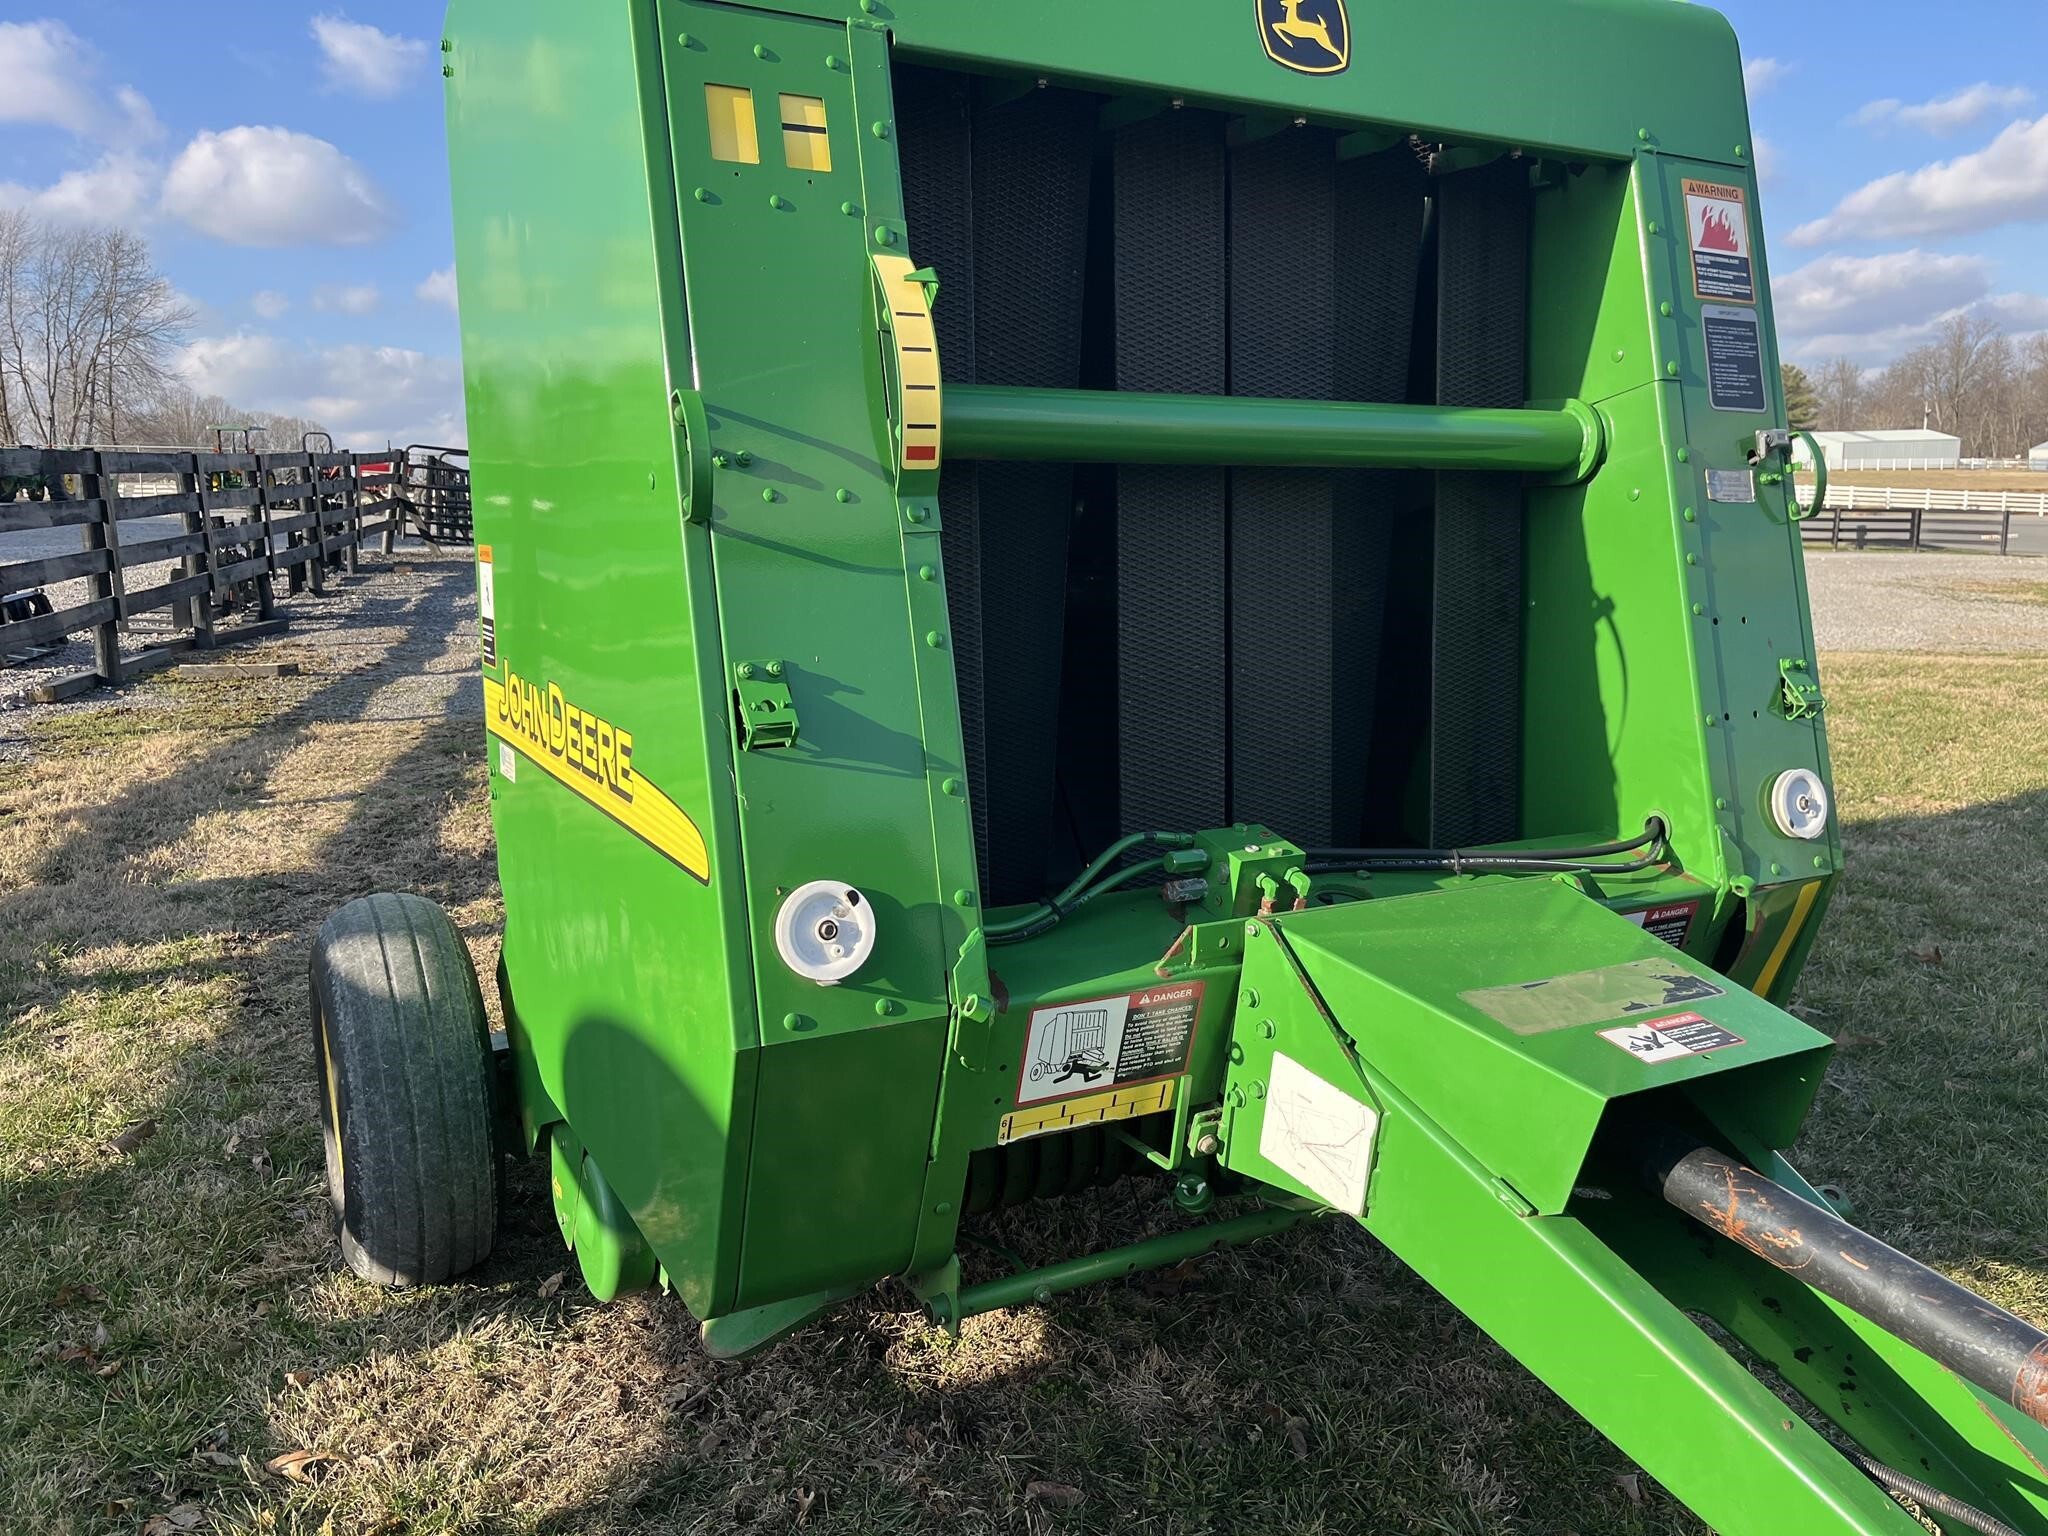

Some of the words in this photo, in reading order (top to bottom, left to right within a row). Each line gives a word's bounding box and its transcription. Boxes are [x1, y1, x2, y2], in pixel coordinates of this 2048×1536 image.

[1695, 183, 1738, 199] WARNING
[499, 658, 549, 748] JOHN
[548, 681, 633, 803] DEERE
[1661, 908, 1689, 918] DANGER
[1153, 989, 1192, 1002] DANGER
